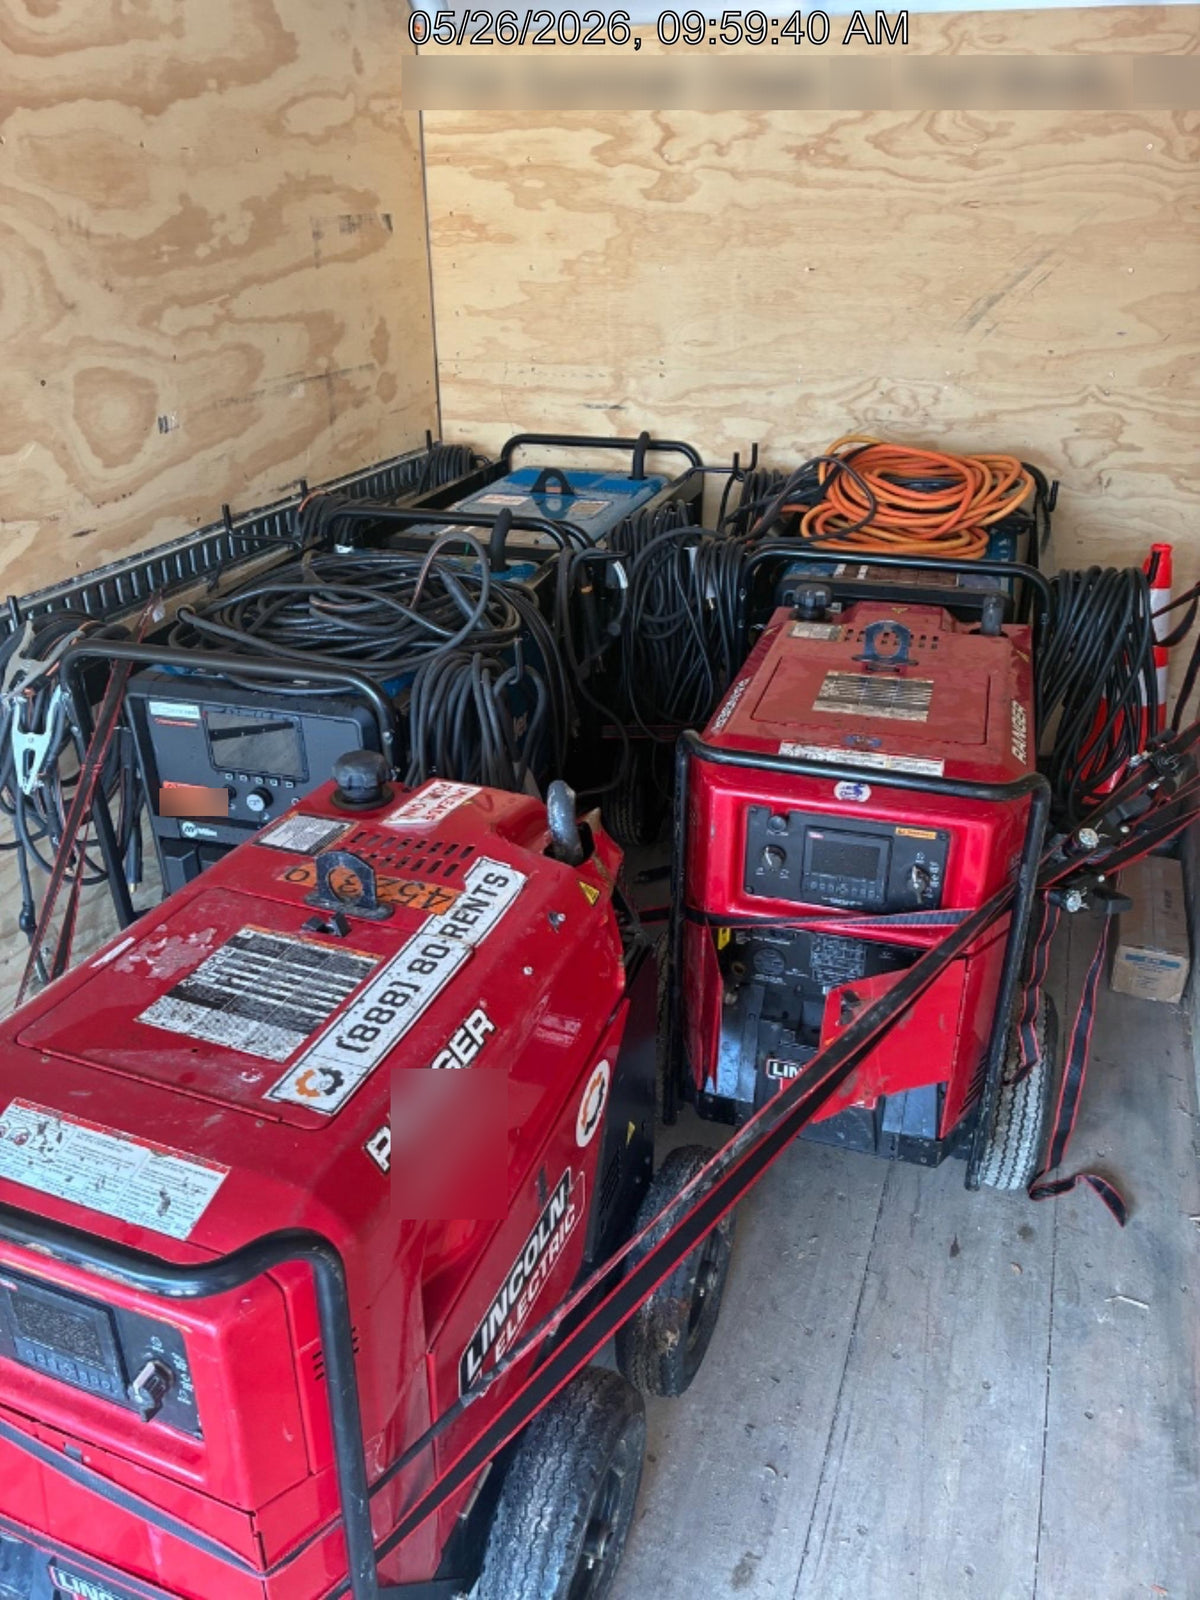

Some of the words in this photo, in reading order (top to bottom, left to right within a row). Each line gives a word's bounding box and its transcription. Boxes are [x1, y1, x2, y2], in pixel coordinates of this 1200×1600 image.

[1011, 699, 1027, 767] RANGER
[335, 980, 422, 1054] (888)
[465, 1183, 567, 1382] LINCOLN
[494, 1203, 576, 1363] ELECTRIC
